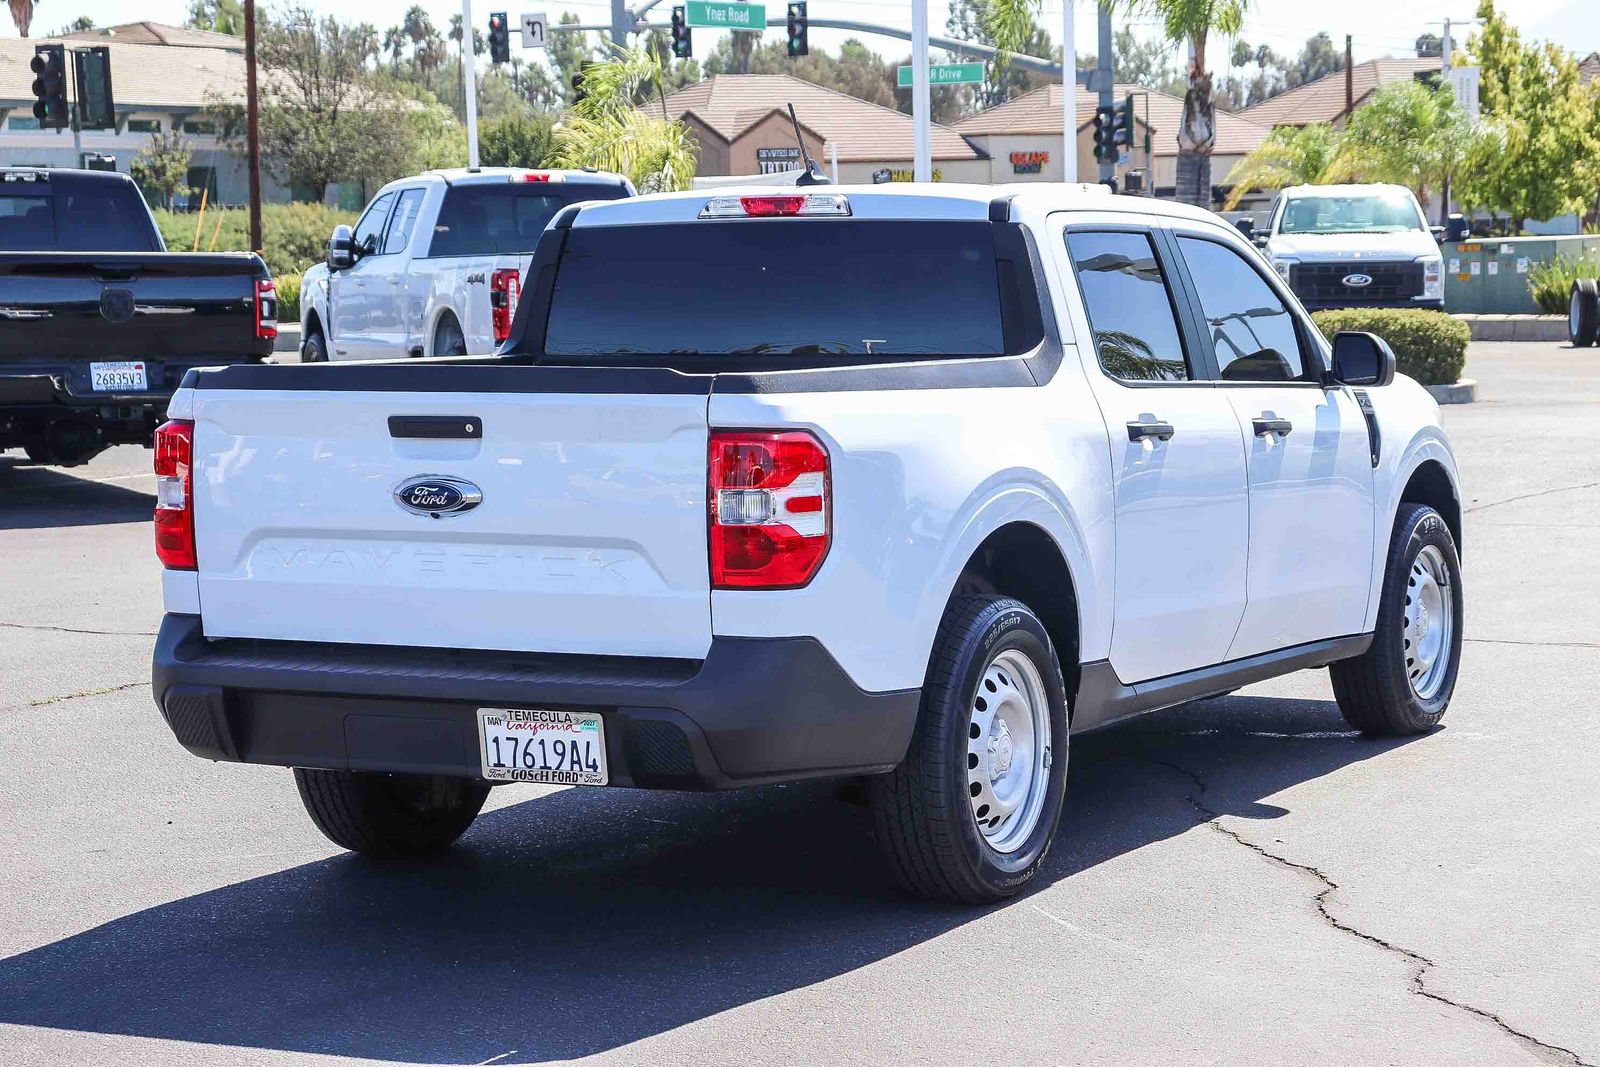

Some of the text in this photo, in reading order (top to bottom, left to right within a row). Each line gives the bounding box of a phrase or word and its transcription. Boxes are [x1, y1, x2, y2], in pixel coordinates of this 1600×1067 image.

[705, 5, 750, 22] Ynez Road
[939, 68, 962, 80] Drive
[760, 160, 800, 174] TATTOO
[96, 372, 142, 386] 26835V3
[411, 486, 448, 505] Ford
[271, 547, 628, 584] MAVERICK
[487, 716, 502, 726] MAY
[507, 710, 572, 723] TEMECULA
[506, 721, 582, 736] California
[492, 735, 598, 773] 17619A4
[487, 769, 506, 779] Ford
[552, 770, 579, 782] FORD
[583, 773, 603, 784] Ford
